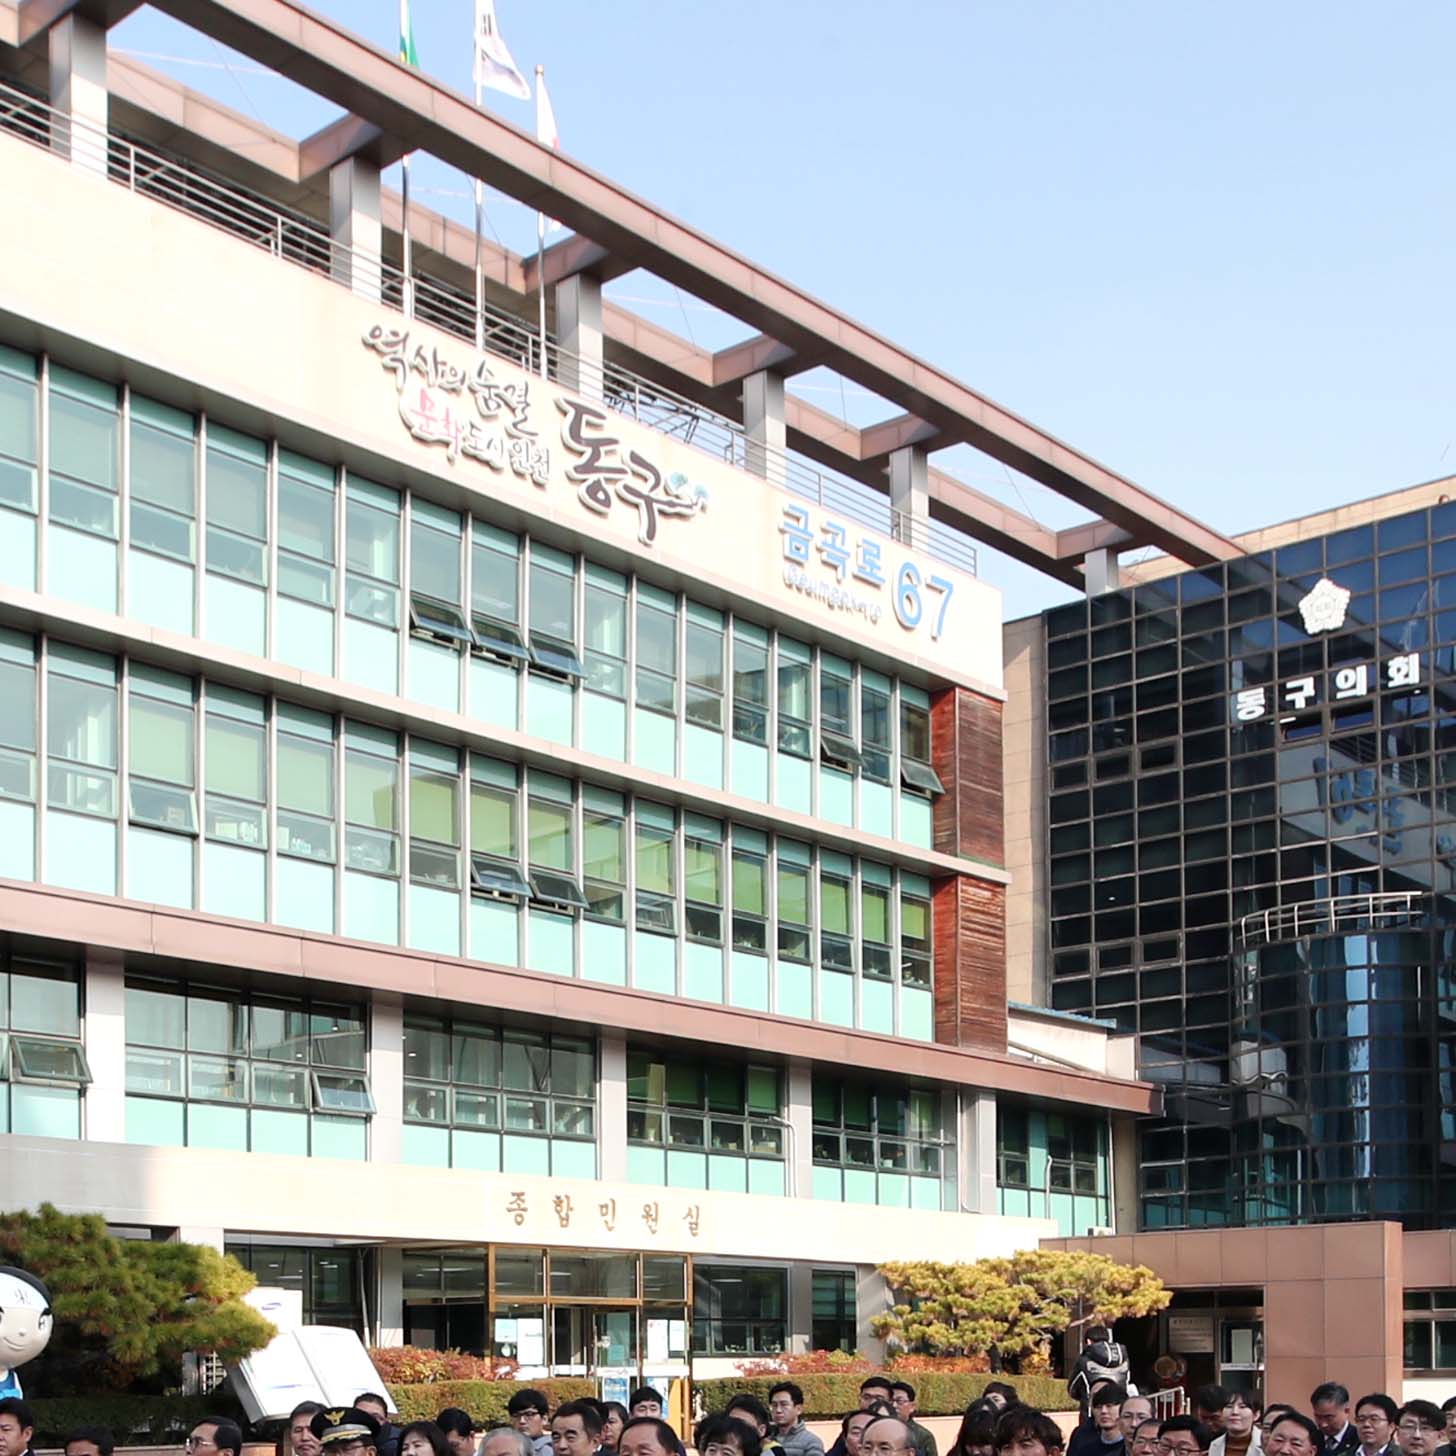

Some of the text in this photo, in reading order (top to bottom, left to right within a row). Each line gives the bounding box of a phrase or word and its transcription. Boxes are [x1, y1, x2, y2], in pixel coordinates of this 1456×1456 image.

[363, 324, 466, 392] 역사의
[558, 397, 700, 543] 동구
[781, 503, 955, 640] 금곡로 67
[1236, 652, 1421, 722] 동구의회
[506, 1191, 700, 1237] 종합민원실
